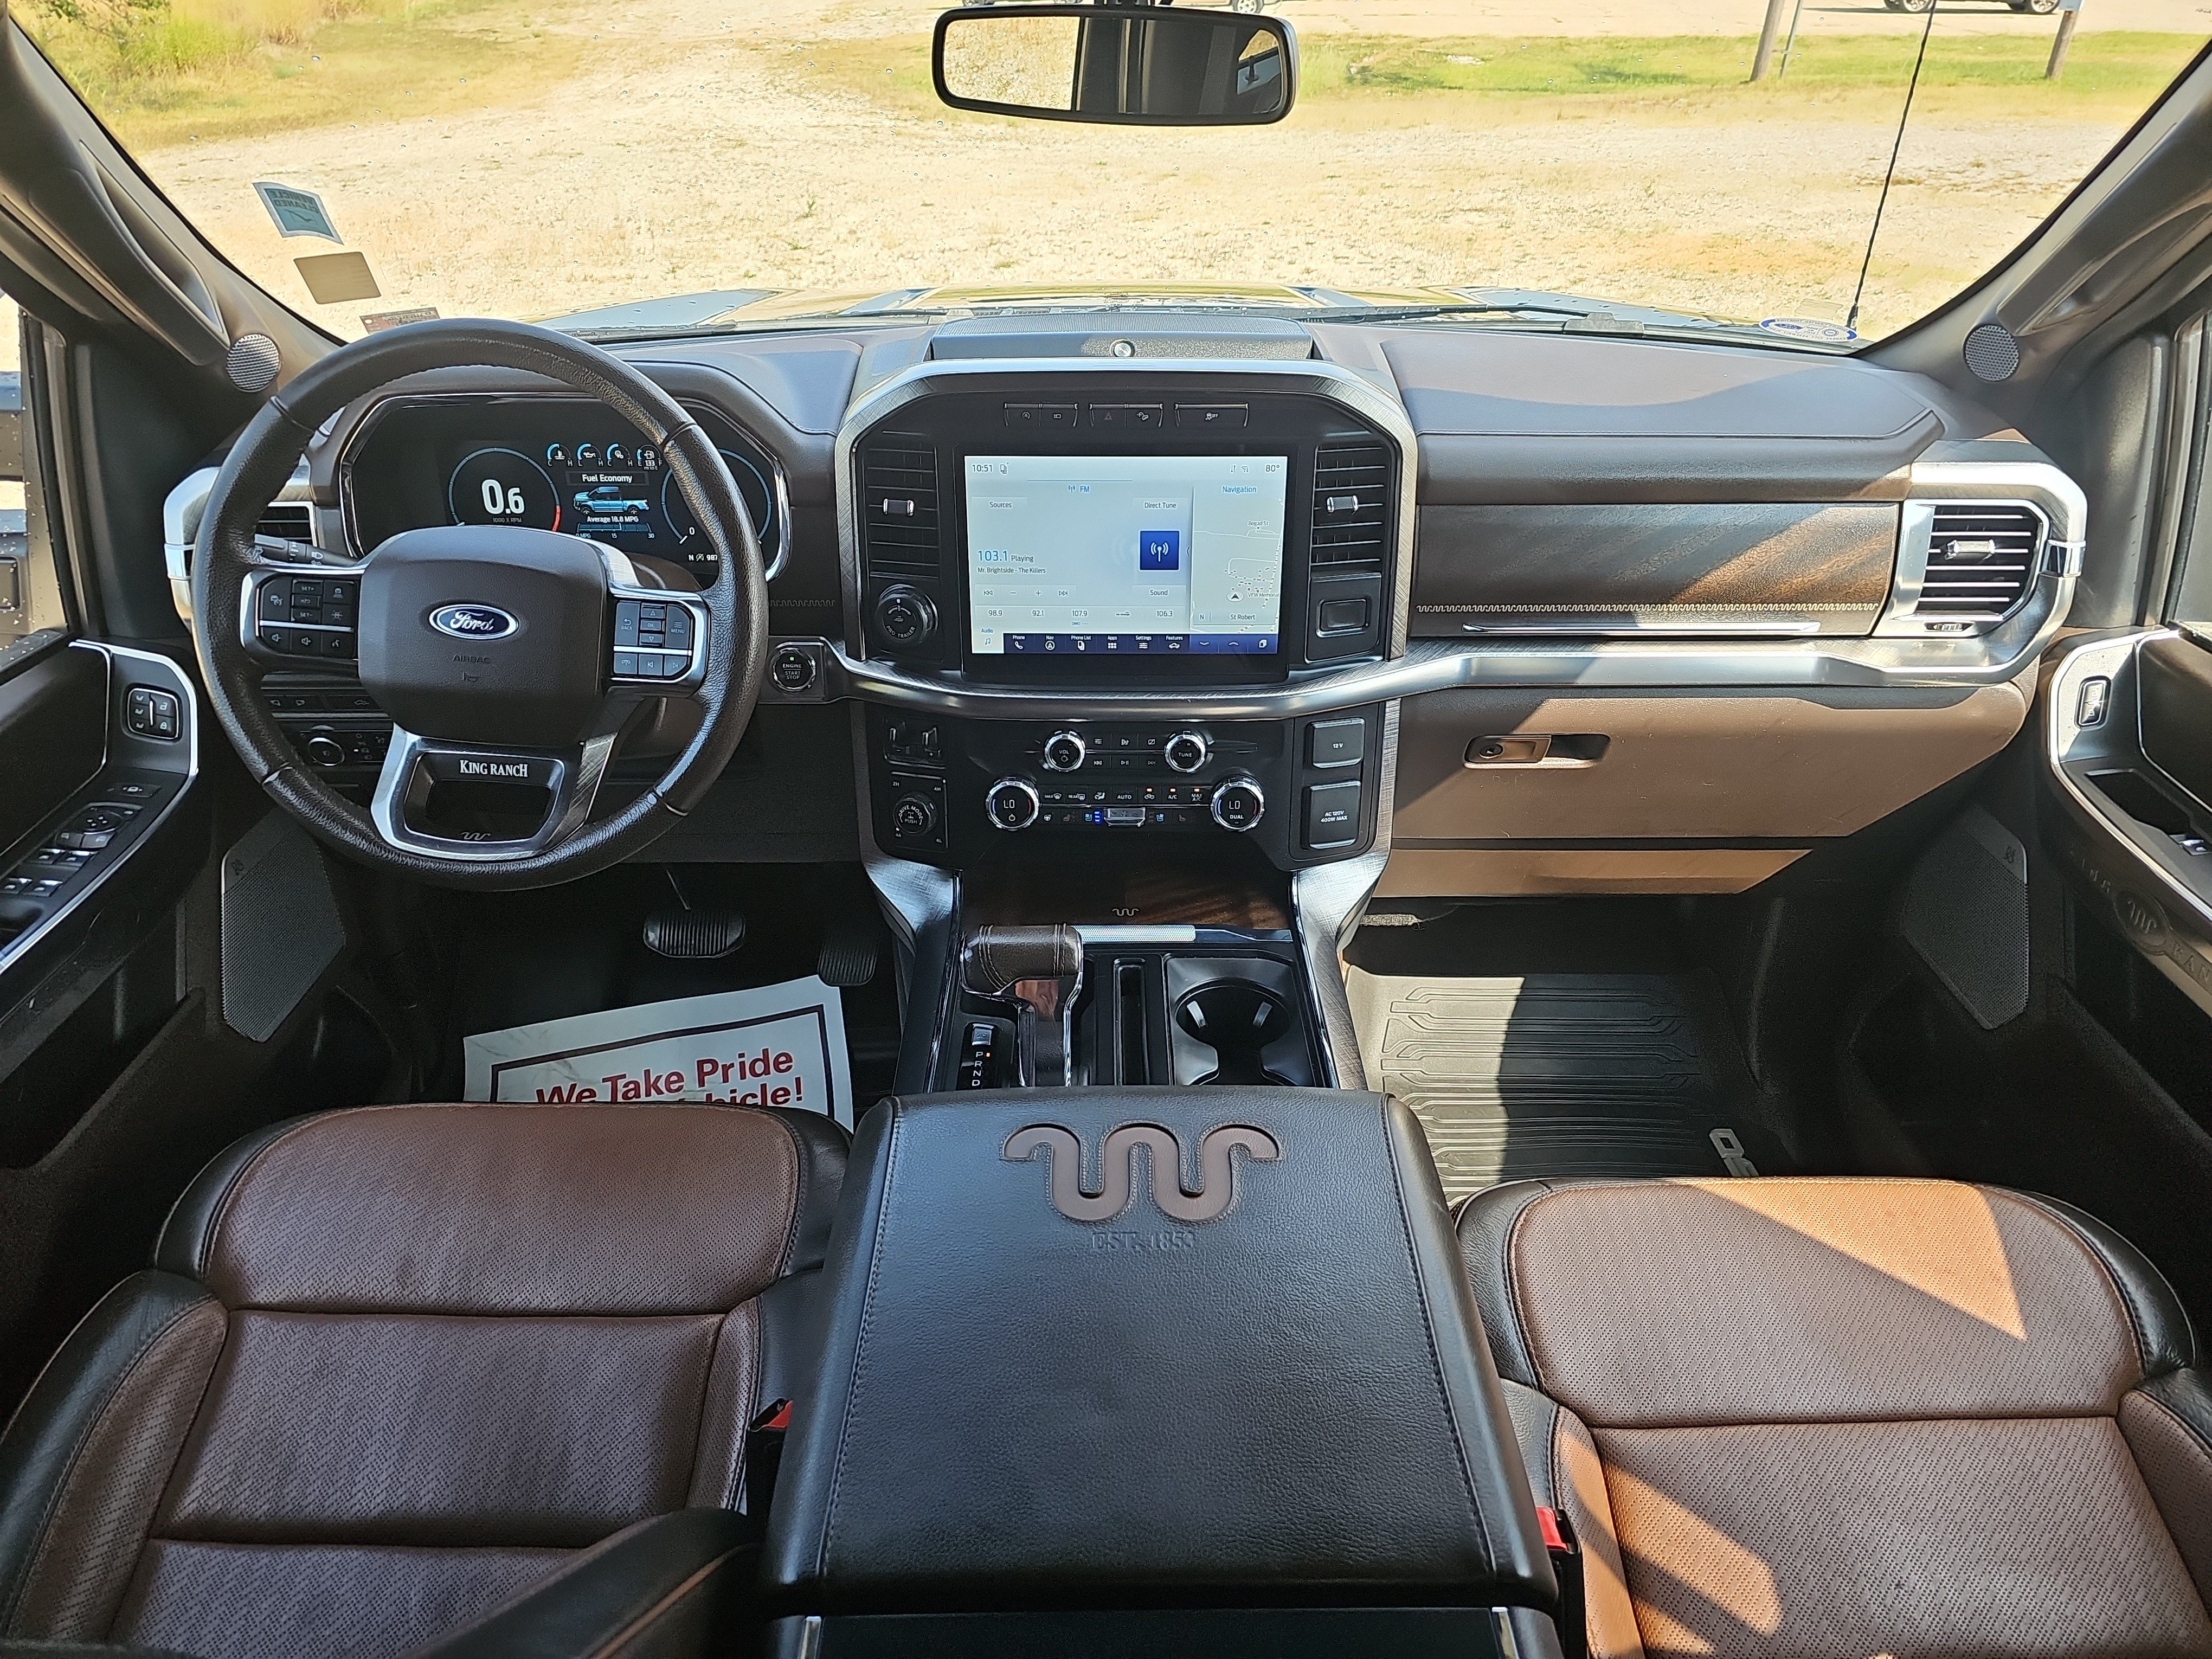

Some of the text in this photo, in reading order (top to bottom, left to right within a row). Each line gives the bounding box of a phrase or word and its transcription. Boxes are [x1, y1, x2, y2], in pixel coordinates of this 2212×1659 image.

[972, 464, 993, 472] 10:51
[600, 474, 633, 483] Economy
[482, 479, 525, 514] 0.6
[1222, 486, 1257, 494] Navigation
[689, 527, 695, 535] 0
[978, 550, 1008, 561] 103.1
[450, 610, 494, 631] Ford
[886, 626, 916, 639] PRO TRAILER
[460, 760, 529, 777] KING RANCH
[1004, 799, 1015, 808] LO
[898, 805, 923, 820] DRIVE MODE
[536, 1048, 794, 1103] We Take Pride
[1149, 1232, 1193, 1249] 1853
